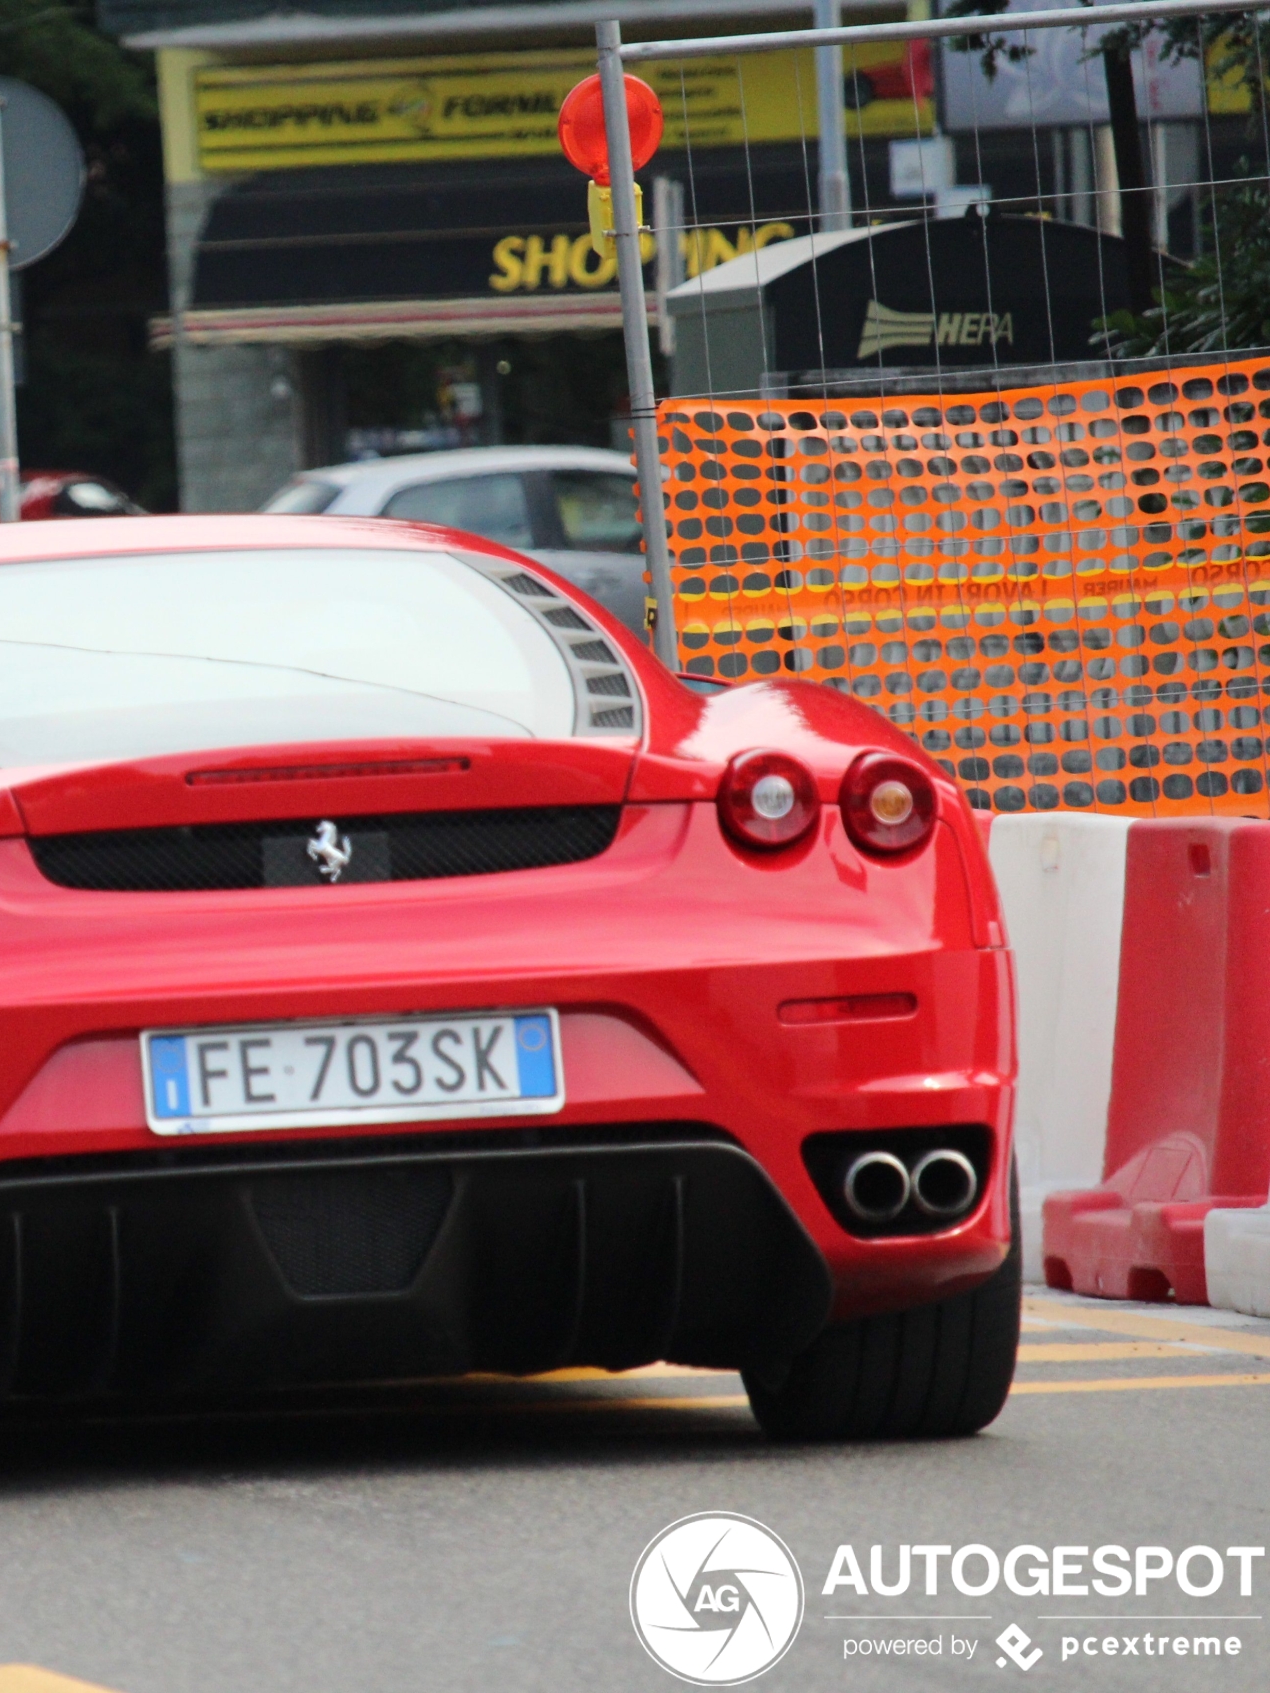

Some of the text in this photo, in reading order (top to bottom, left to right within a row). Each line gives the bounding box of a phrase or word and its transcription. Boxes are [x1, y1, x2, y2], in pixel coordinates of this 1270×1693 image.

[936, 311, 1014, 346] HERA
[197, 1025, 509, 1107] FE 703SK
